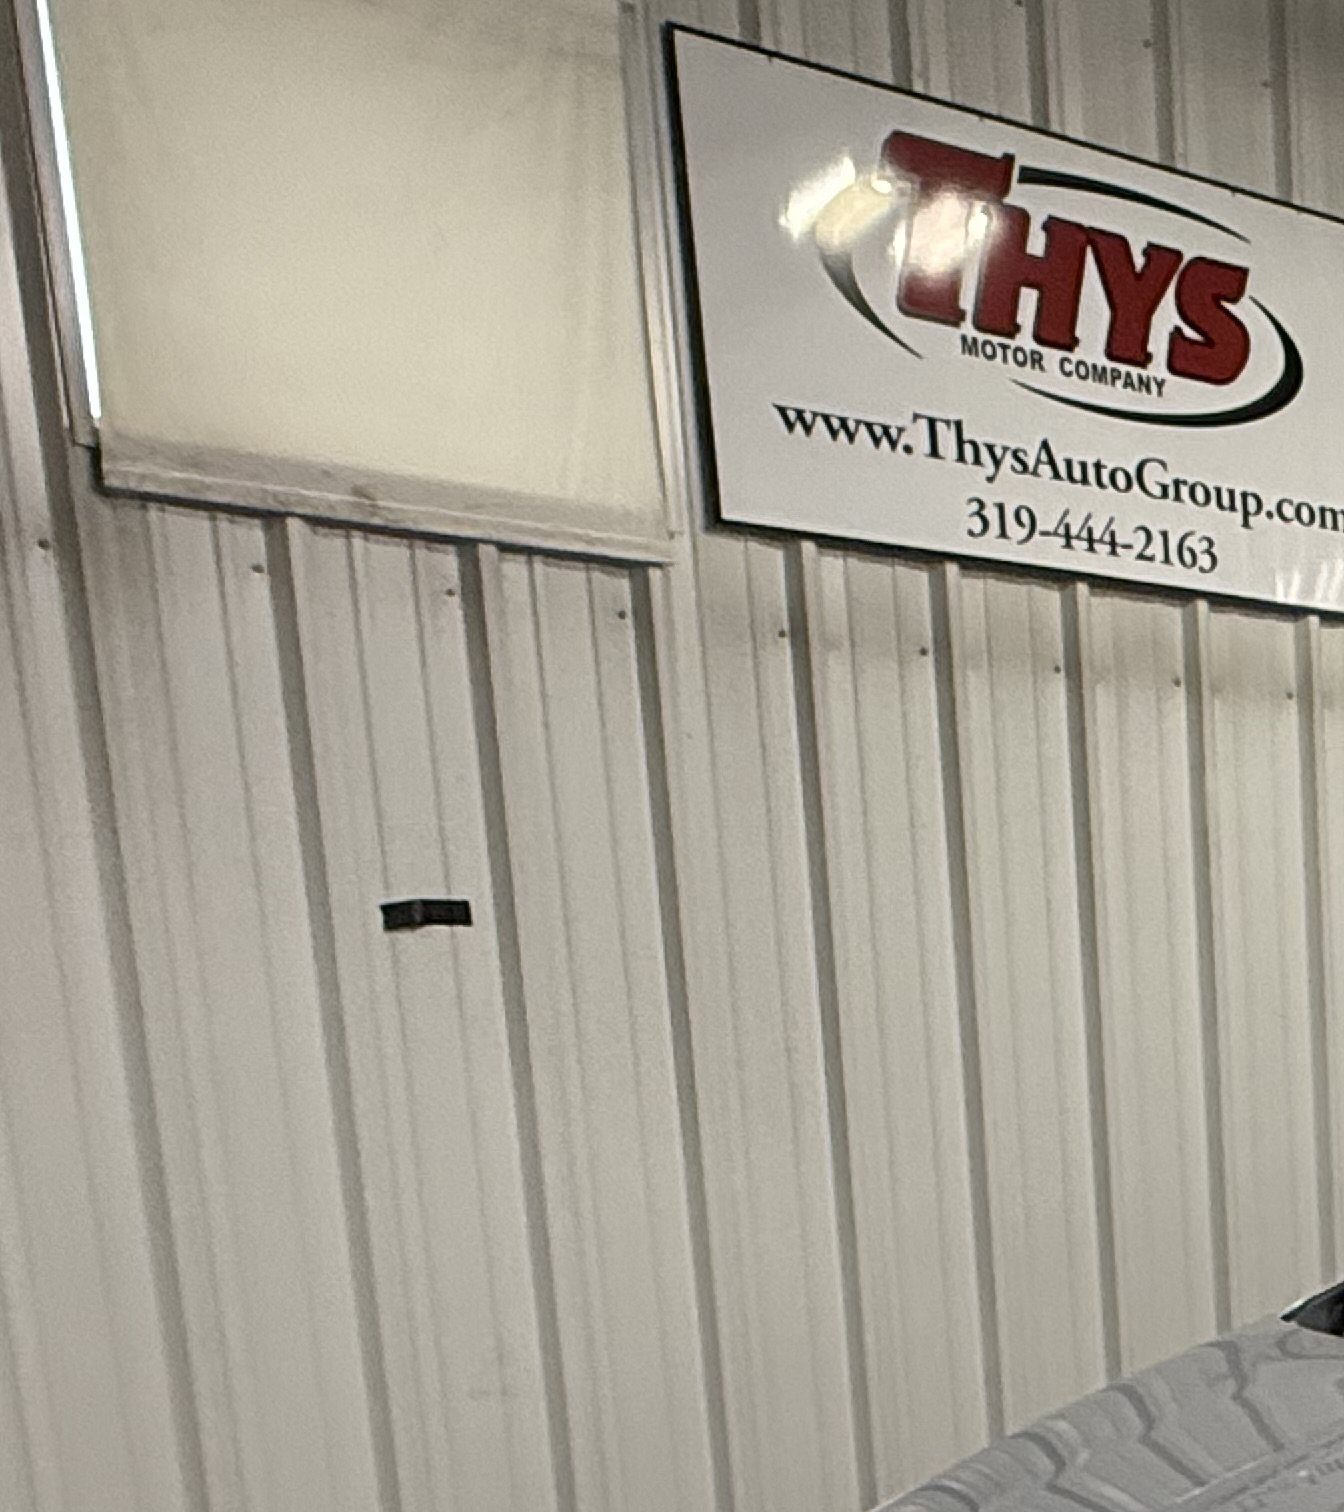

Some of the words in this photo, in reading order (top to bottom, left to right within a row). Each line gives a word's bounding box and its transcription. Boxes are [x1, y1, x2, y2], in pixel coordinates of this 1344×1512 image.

[881, 130, 1251, 386] THYS
[960, 333, 1045, 373] MOTOR
[1059, 357, 1167, 399] COMPANY
[966, 497, 1219, 574] 319-444-2163
